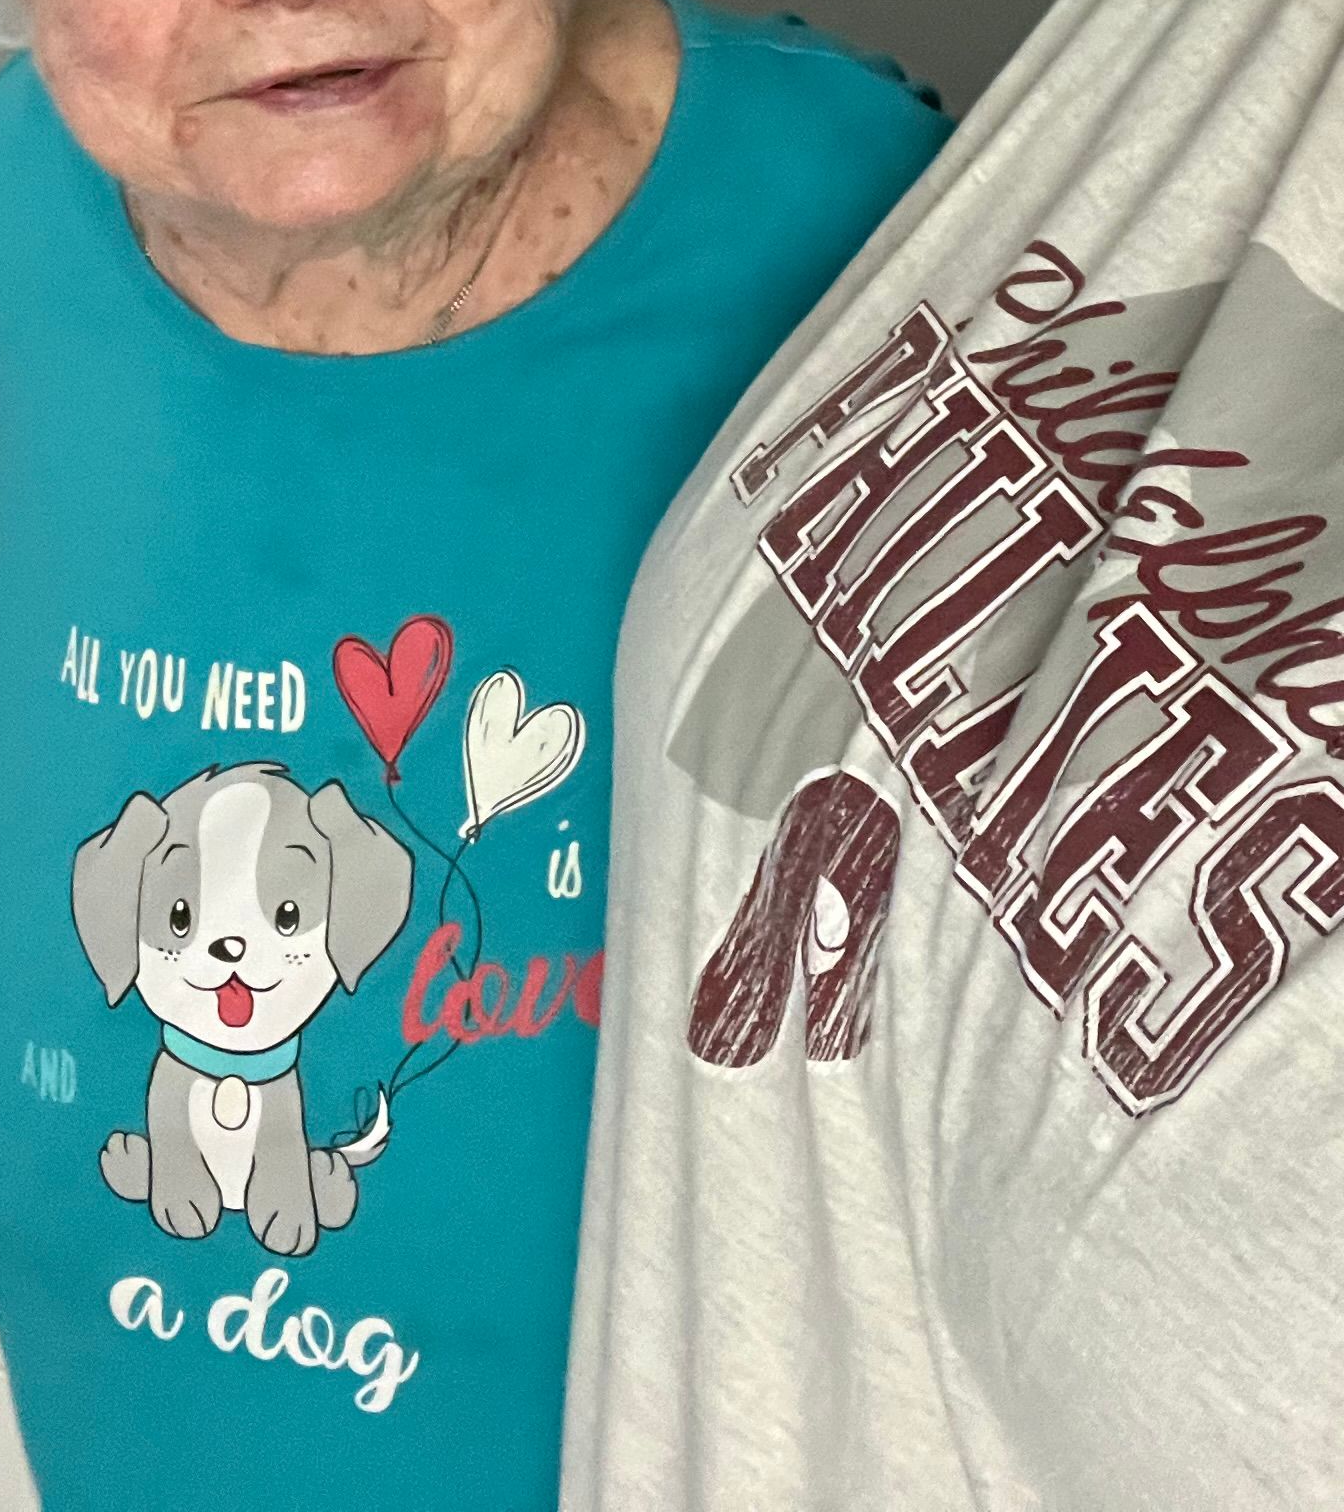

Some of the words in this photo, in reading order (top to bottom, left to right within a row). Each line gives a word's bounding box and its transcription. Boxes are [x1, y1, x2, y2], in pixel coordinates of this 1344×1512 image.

[60, 625, 100, 705] ALL
[120, 648, 187, 721] YOU
[200, 660, 307, 734] NEED
[547, 819, 583, 899] is
[19, 1041, 77, 1104] AND
[109, 1274, 184, 1342] a
[206, 1268, 420, 1416] dog
